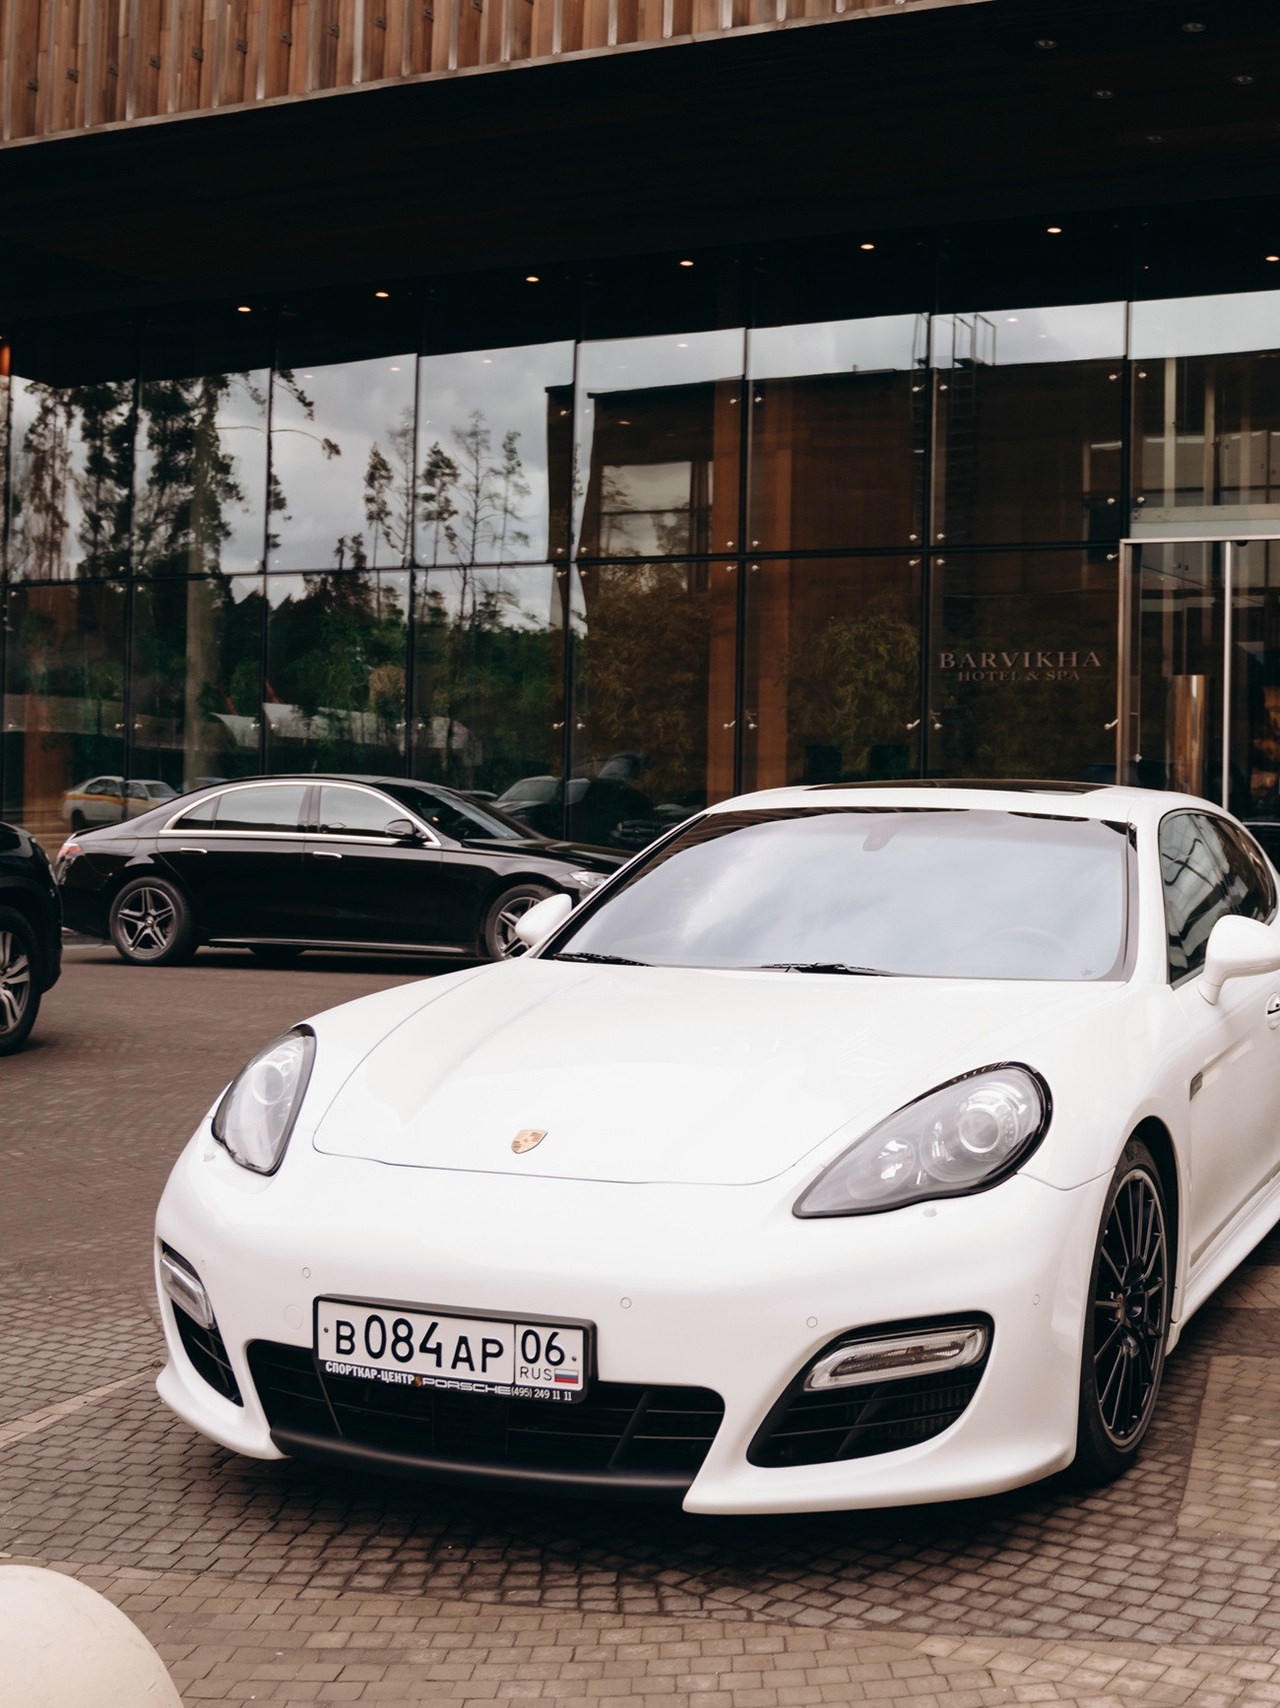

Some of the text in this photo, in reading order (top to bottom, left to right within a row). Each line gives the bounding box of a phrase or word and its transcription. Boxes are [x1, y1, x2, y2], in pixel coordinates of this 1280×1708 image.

[939, 651, 1101, 668] BARVIKHA
[958, 670, 1080, 682] HOTEL & SPA
[520, 1328, 566, 1367] 06
[325, 1361, 415, 1385] СПОРТКАР-ЦЕНТР
[422, 1377, 511, 1395] PORSCHE
[511, 1387, 532, 1398] (495)
[534, 1388, 550, 1399] 249
[520, 1366, 553, 1381] RUS
